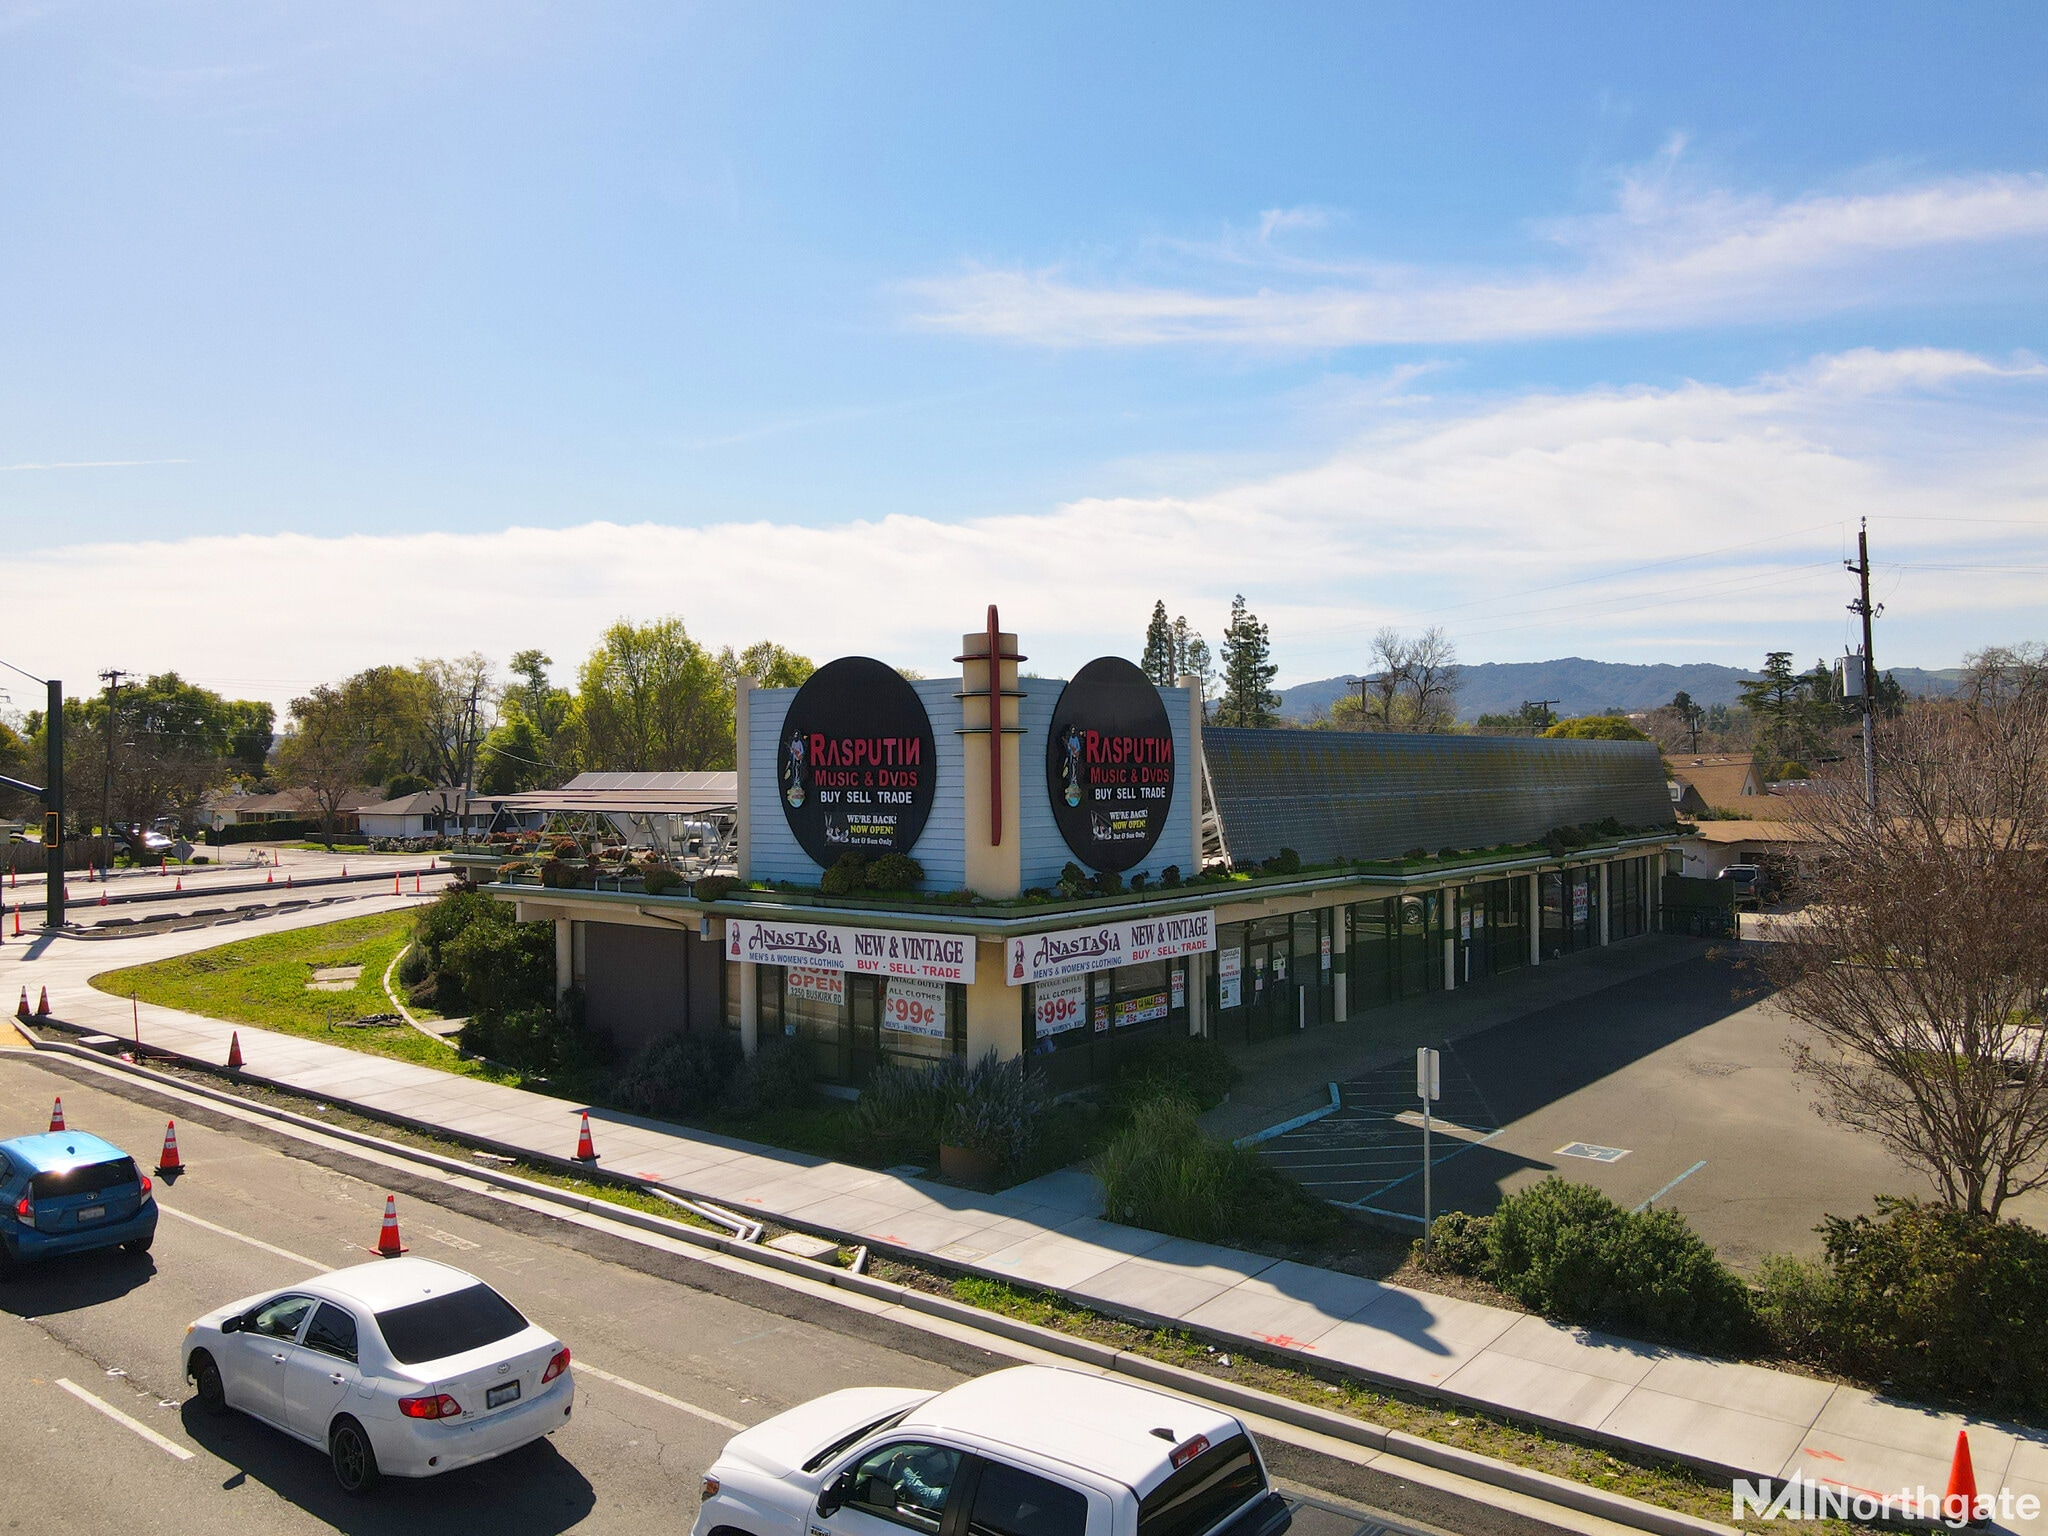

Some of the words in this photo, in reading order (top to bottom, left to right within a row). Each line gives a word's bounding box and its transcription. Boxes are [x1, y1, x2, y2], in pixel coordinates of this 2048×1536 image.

[810, 733, 920, 766] RASPUTIN
[1086, 730, 1172, 763] RASPUTIN
[815, 770, 859, 787] MUSIC
[864, 771, 874, 787] &
[878, 769, 918, 787] DVDS
[1090, 767, 1127, 784] MUSIC
[1131, 768, 1138, 783] &
[1141, 766, 1170, 783] DVDS
[820, 791, 841, 803] BUY
[846, 791, 871, 803] SELL
[877, 791, 912, 804] TRADE
[1095, 788, 1112, 800] BUY
[1116, 787, 1136, 799] SELL
[1140, 786, 1166, 799] TRADE
[847, 814, 872, 824] WE'RE
[872, 815, 897, 824] BACK!
[1109, 811, 1129, 820] WE'RE
[1130, 809, 1148, 819] BACK!
[850, 825, 869, 834] NOW
[869, 825, 894, 835] OPEN!
[1112, 821, 1127, 830] NOW
[1128, 819, 1146, 829] OPEN!
[867, 837, 878, 845] Sun
[878, 837, 893, 847] Only
[1131, 924, 1155, 947] NEW
[1157, 922, 1165, 944] &
[1166, 916, 1208, 942] VINTAGE
[855, 934, 886, 957] NEW
[889, 936, 899, 959] &
[901, 937, 964, 964] VINTAGE
[1132, 949, 1151, 960] BUY
[1157, 945, 1178, 957] SELL
[1181, 940, 1207, 952] TRADE
[749, 952, 769, 962] MEN'S
[771, 953, 776, 962] &
[777, 954, 808, 965] WOMEN'S
[809, 957, 844, 969] CLOTHING
[857, 959, 879, 970] BUY
[889, 962, 916, 975] SELL
[922, 965, 961, 979] TRADE
[1033, 967, 1053, 979] MEN'S
[1054, 967, 1060, 975] &
[1061, 961, 1091, 974] WOMEN'S
[1091, 956, 1122, 969] CLOTHING
[789, 973, 842, 993] OPEN
[891, 976, 916, 986] INTAGE
[917, 980, 944, 990] OUTLET
[791, 987, 804, 998] 3250
[806, 989, 832, 1003] BUSKIRK
[833, 993, 842, 1004] RD
[889, 987, 904, 996] ALL
[905, 989, 942, 1002] CLOTHES
[1039, 993, 1050, 1001] ALL
[1052, 986, 1082, 998] CLOTHES
[887, 998, 935, 1026] $99¢
[1037, 996, 1077, 1024] $99¢
[1156, 1007, 1166, 1017] 25¢
